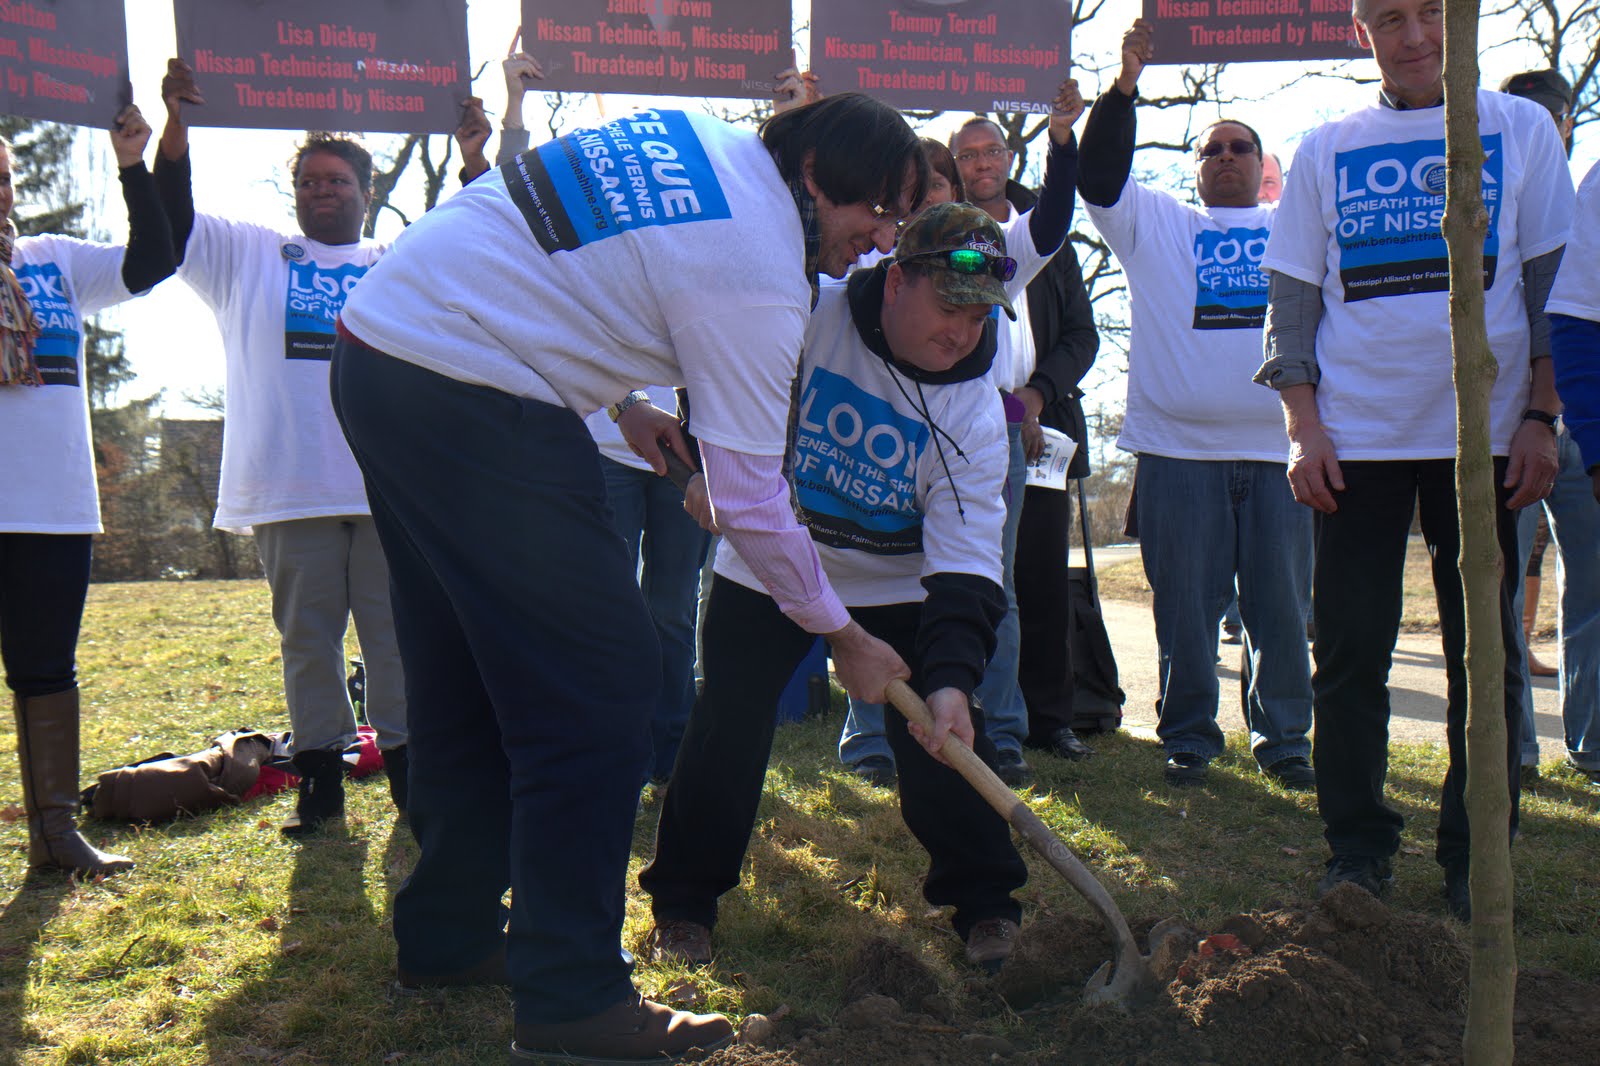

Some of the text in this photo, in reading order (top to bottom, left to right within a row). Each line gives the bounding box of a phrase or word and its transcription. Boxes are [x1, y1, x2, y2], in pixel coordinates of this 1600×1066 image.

[1157, 0, 1210, 17] Nissan
[277, 21, 377, 53] Lisa Dickey
[537, 19, 779, 54] Nissan Technician, Mississippi
[889, 10, 997, 37] Tommy Terrell
[1189, 21, 1355, 47] Threatened by Nissa
[29, 36, 118, 79] Mississippi
[572, 51, 746, 81] Threatened by Nissan
[825, 36, 1059, 69] Nissan Technician, Mississippi
[195, 49, 457, 87] Nissan Technician, Mississippi
[857, 66, 1026, 95] Threatened by Nissan
[7, 67, 28, 97] by
[33, 70, 89, 104] Nissan
[235, 83, 425, 115] Threatened by Nissan
[993, 100, 1053, 114] NISSAN
[577, 132, 632, 224] NISSAN!
[622, 153, 656, 219] VERNIS
[640, 140, 702, 218] QUE
[1341, 195, 1444, 217] BENEATH THE
[1339, 215, 1376, 238] OF
[1197, 237, 1267, 266] LOO
[291, 270, 361, 297] LOO
[1200, 264, 1260, 275] ENEATH TH
[1228, 273, 1270, 288] NISS
[1383, 273, 1411, 284] Alliance
[1412, 272, 1424, 281] for
[17, 274, 65, 298] OK
[290, 290, 342, 307] BENEATH
[290, 300, 321, 312] OF
[797, 435, 855, 470] ENEATH
[858, 462, 887, 483] THE
[809, 522, 838, 536] Alliance
[851, 534, 882, 548] Fairness
